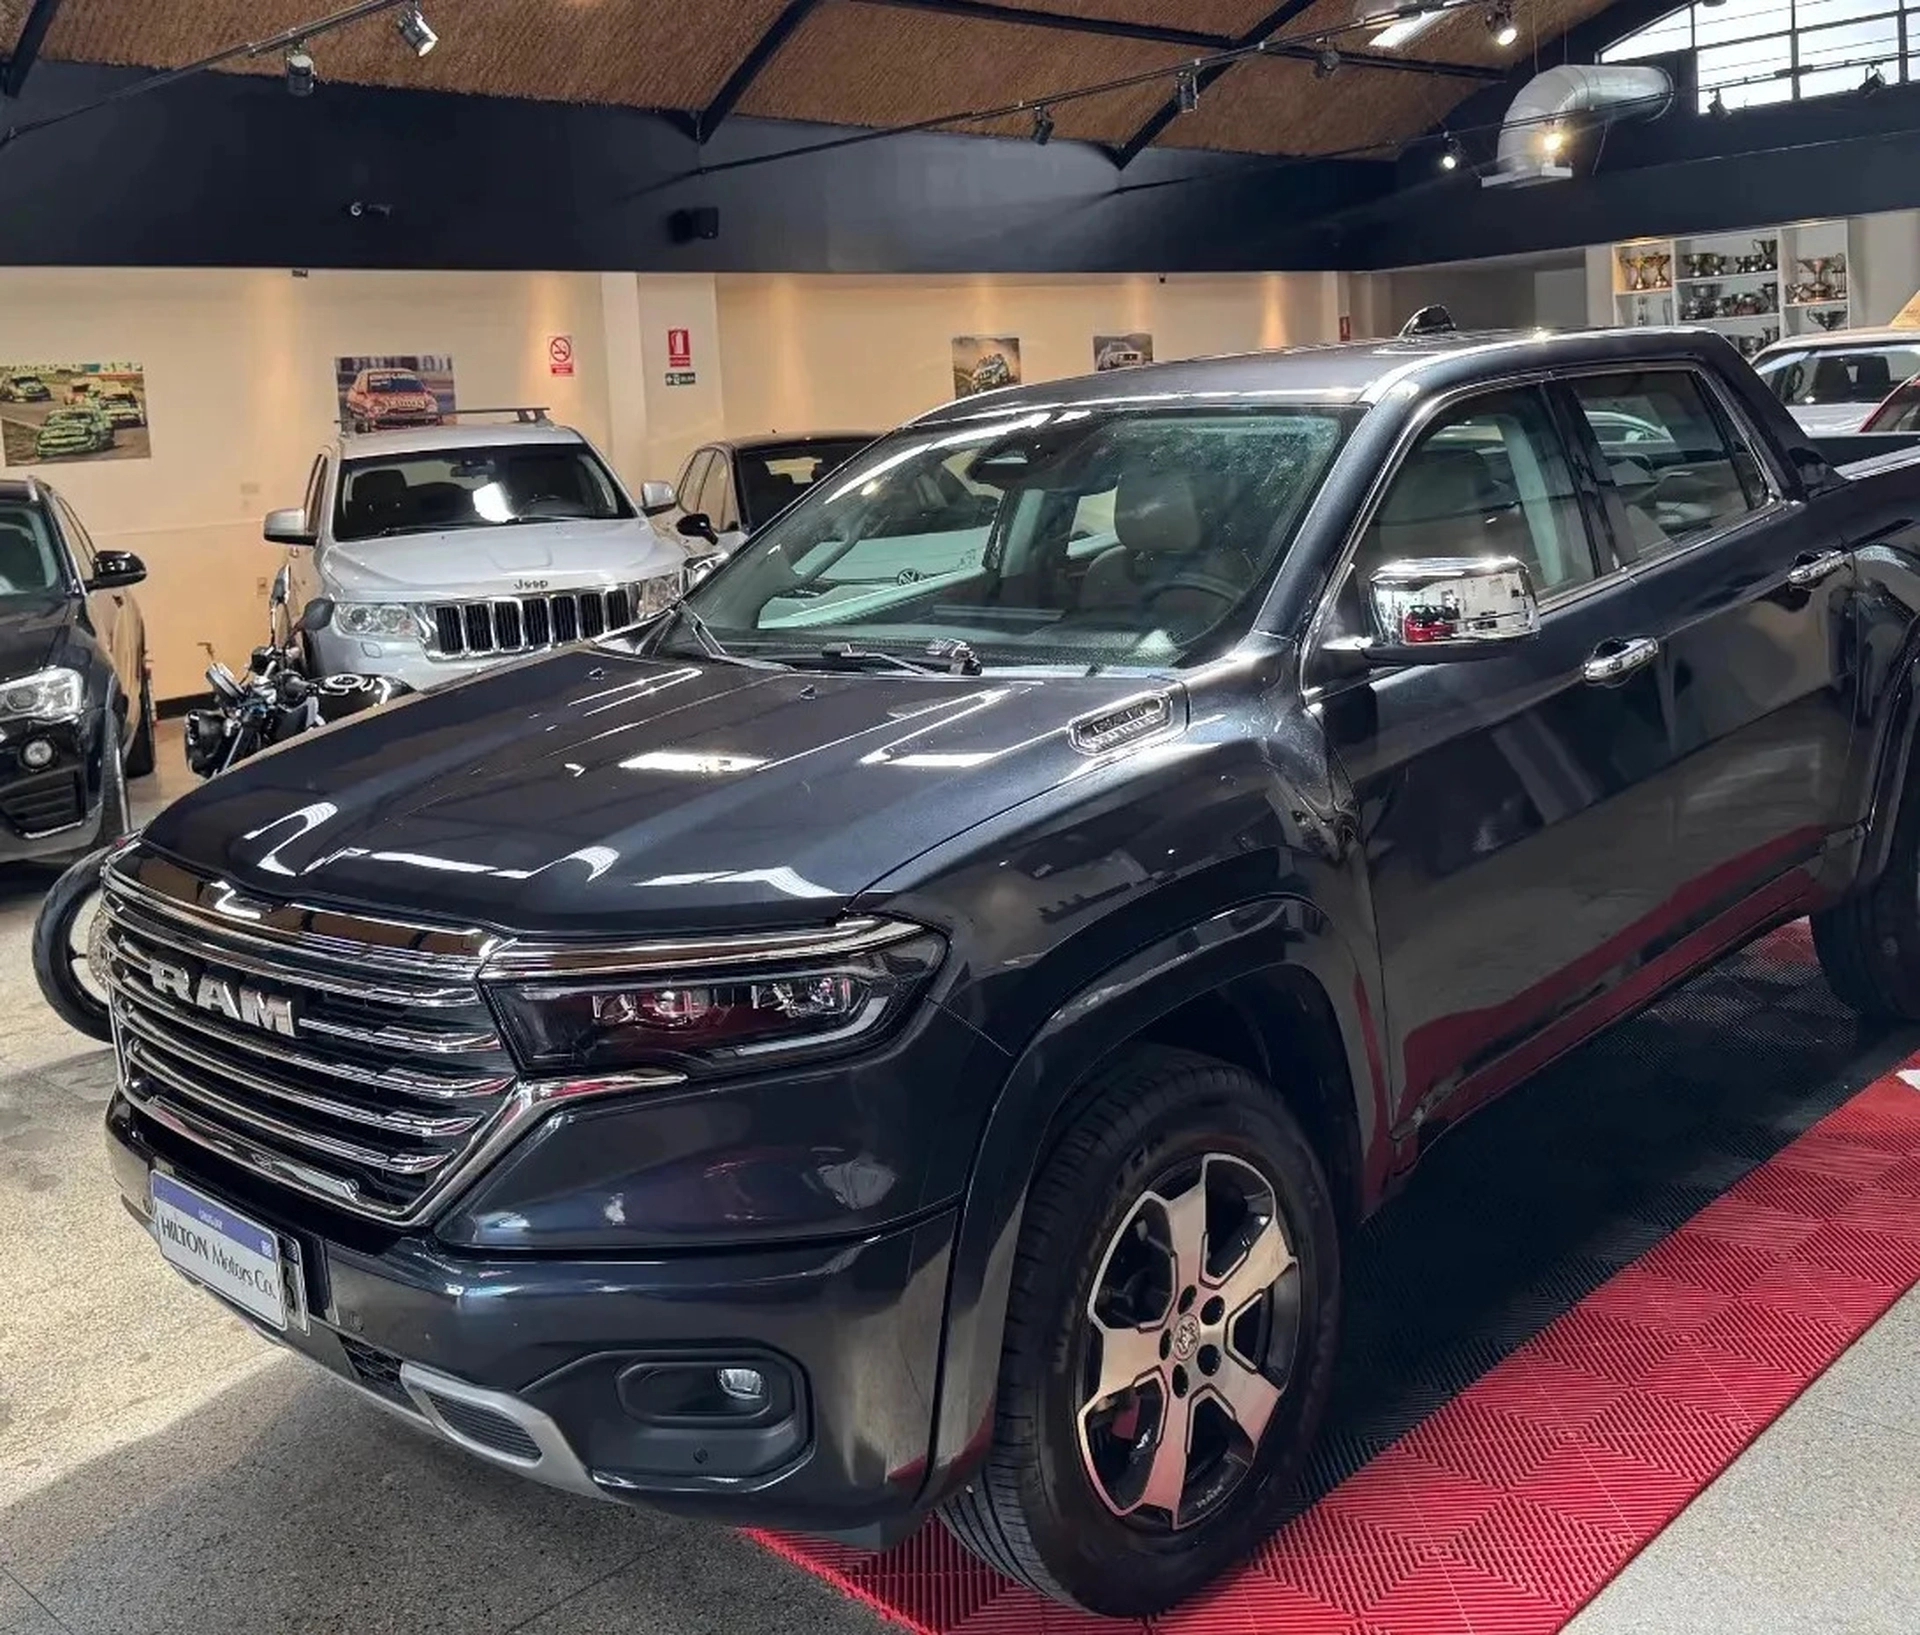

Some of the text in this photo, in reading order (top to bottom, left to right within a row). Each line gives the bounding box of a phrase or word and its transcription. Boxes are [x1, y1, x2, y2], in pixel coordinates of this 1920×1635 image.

[512, 578, 549, 590] Jeep
[149, 957, 296, 1038] RAM
[160, 1216, 209, 1260] HILTON
[212, 1243, 253, 1286] Motors
[254, 1269, 278, 1299] Co.
